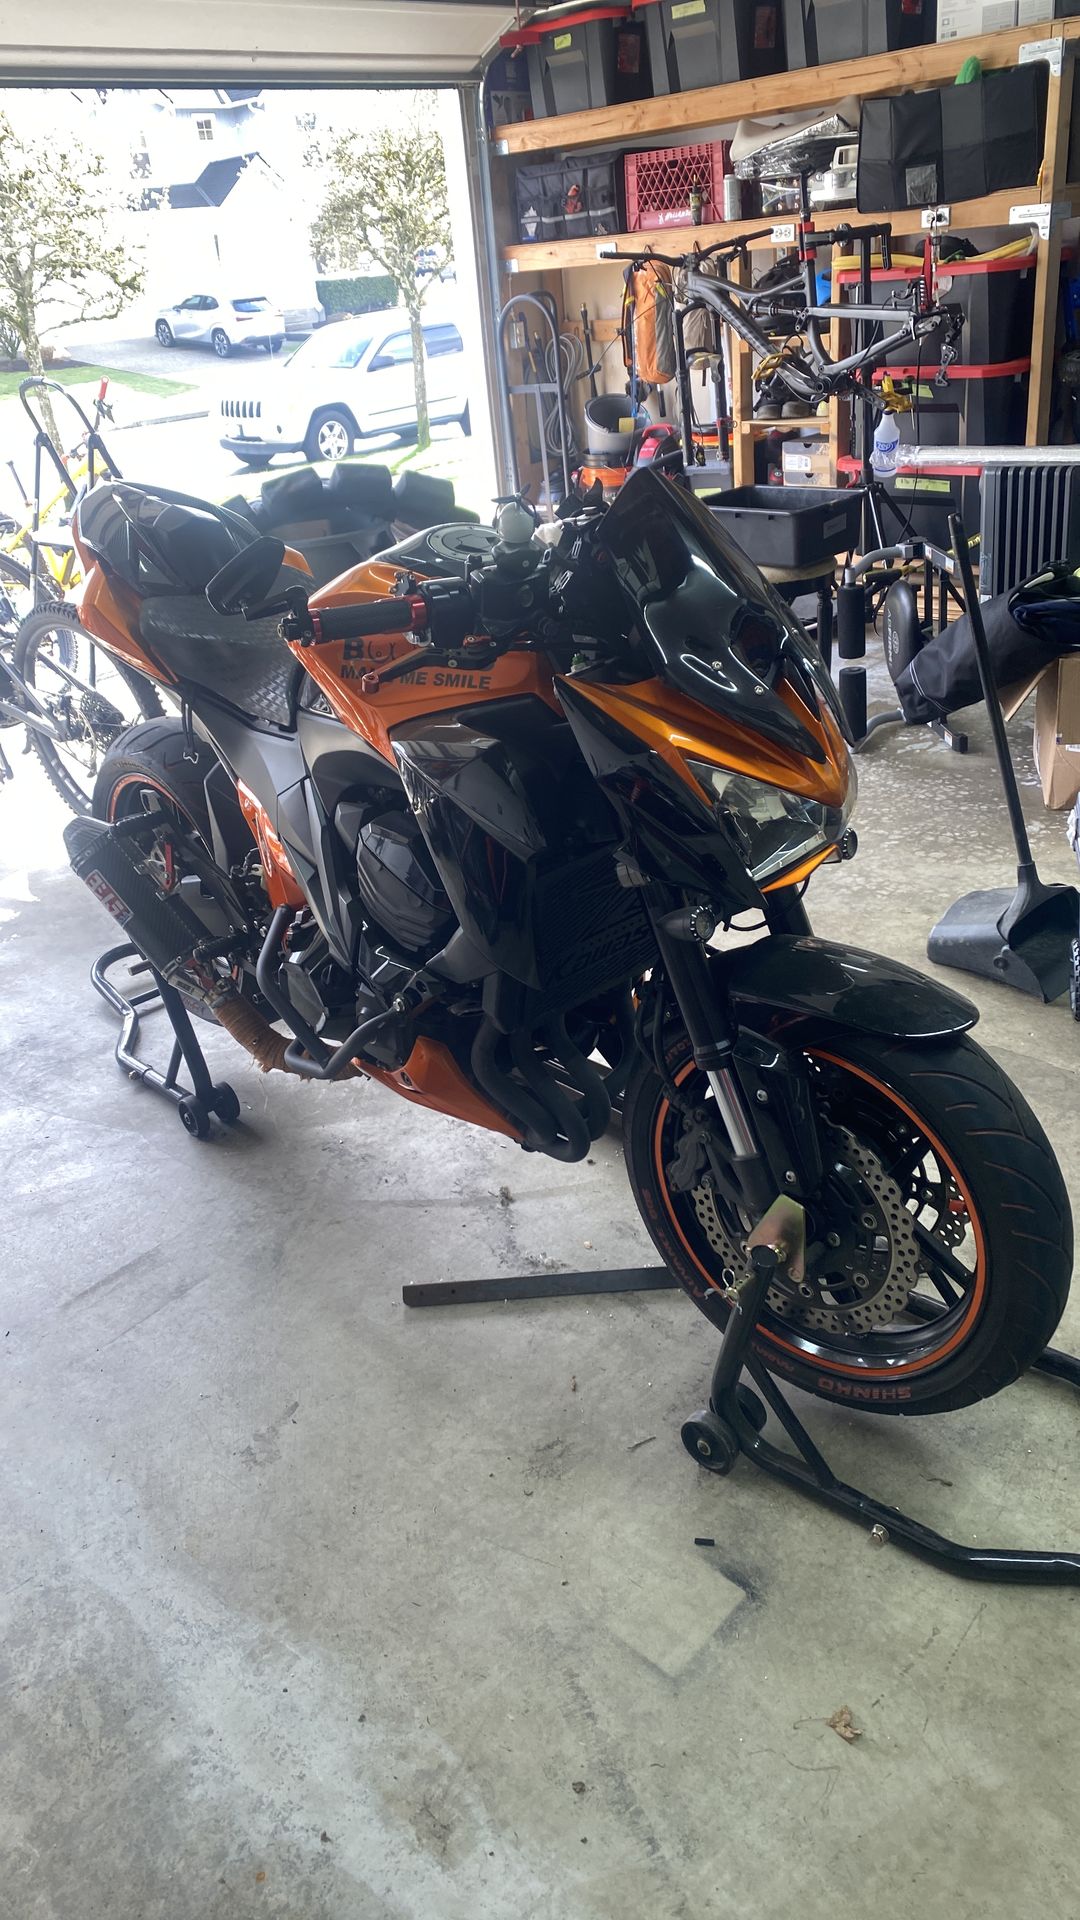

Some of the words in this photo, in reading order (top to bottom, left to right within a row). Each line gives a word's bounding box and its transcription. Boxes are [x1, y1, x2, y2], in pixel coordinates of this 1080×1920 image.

[402, 671, 428, 686] ME
[434, 673, 492, 690] SMILE
[817, 1376, 912, 1400] SHINKO
